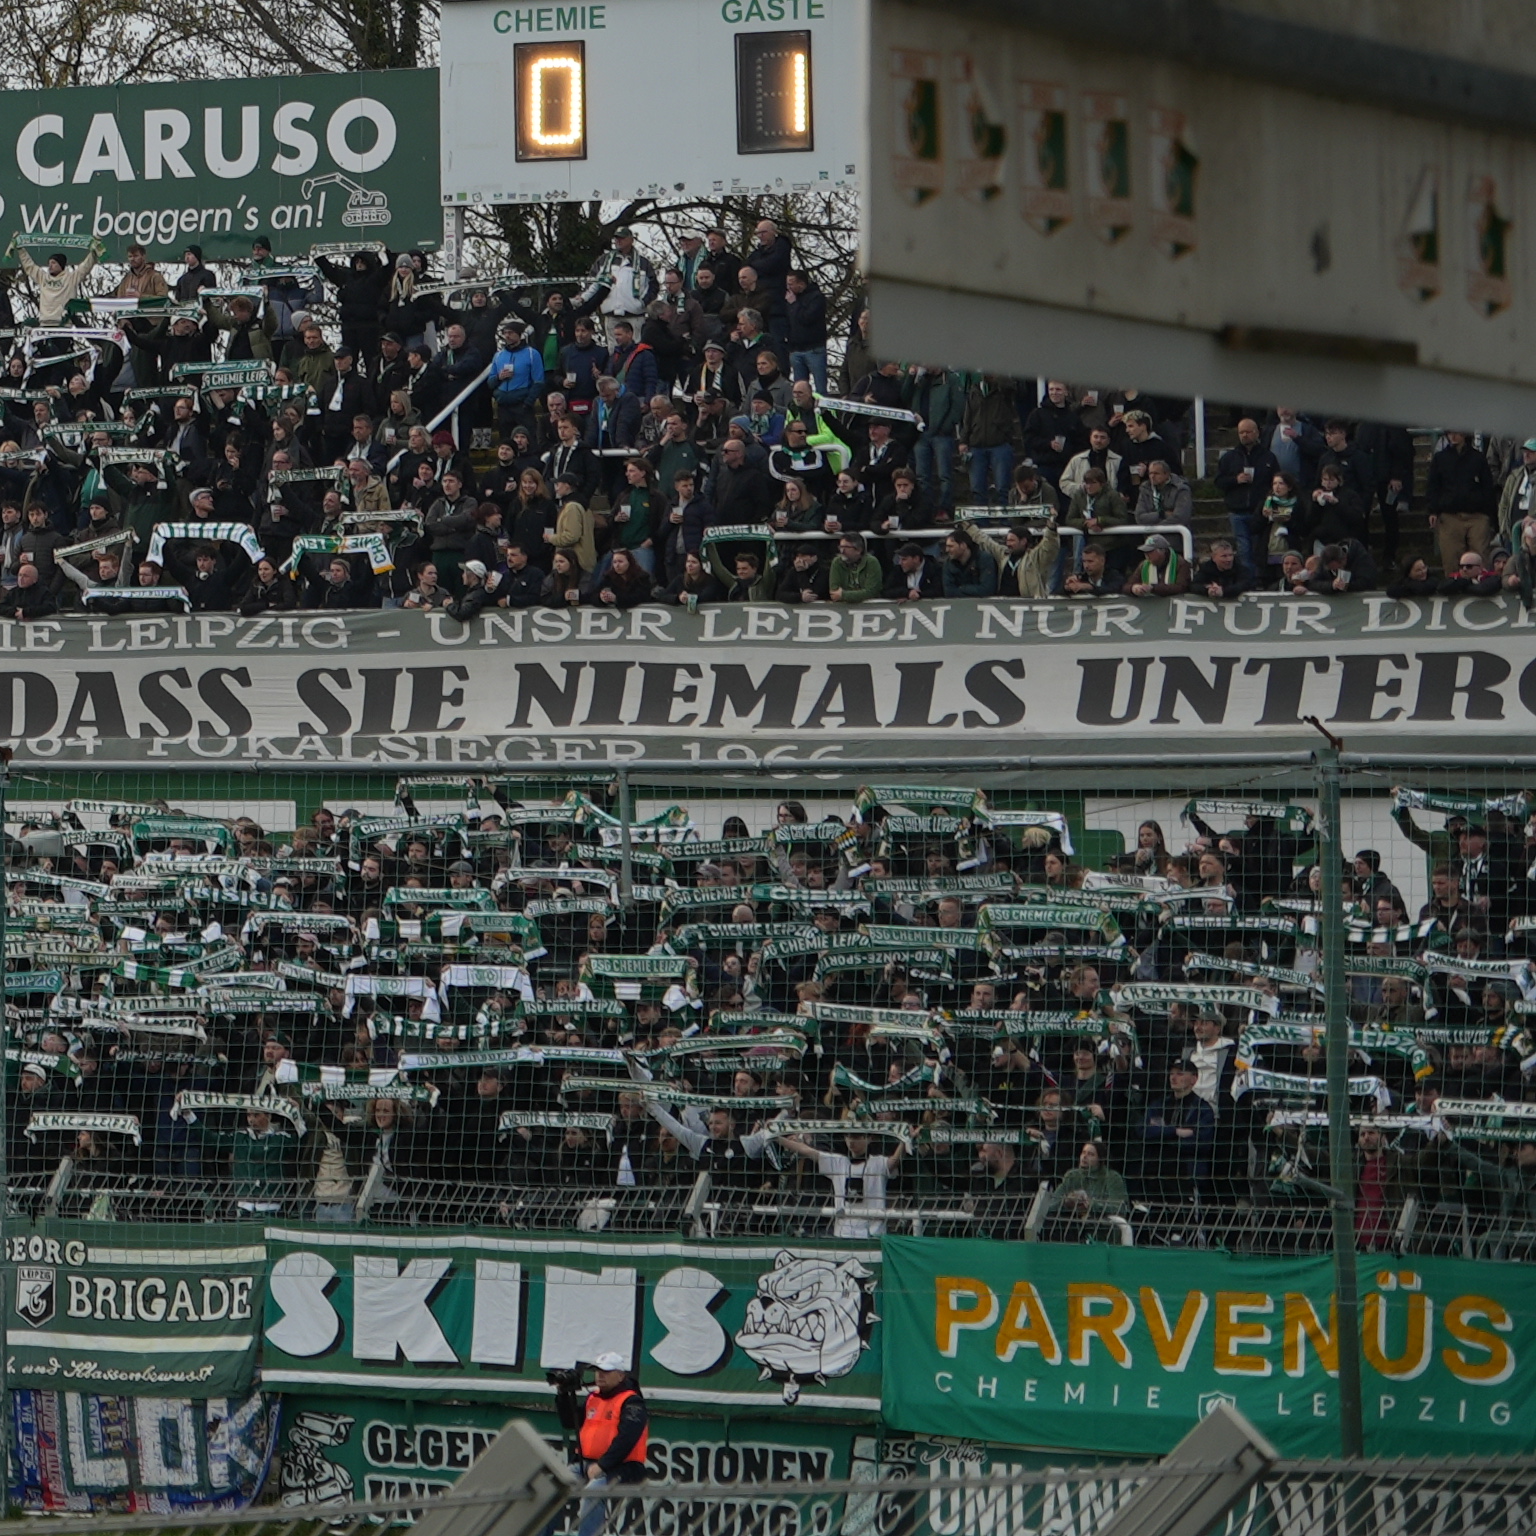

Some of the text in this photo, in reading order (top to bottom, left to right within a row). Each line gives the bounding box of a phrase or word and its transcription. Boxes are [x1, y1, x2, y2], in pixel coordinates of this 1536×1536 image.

[493, 5, 607, 34] CHEMIE
[530, 56, 582, 146] 0
[793, 52, 807, 133] 1
[16, 97, 398, 187] CARUSO
[21, 191, 326, 245] Wir baggern's an!
[88, 614, 348, 652] LEIPZIG
[425, 605, 676, 647] UNSER
[698, 606, 952, 644] LEBEN
[975, 602, 1144, 640] NUR
[1168, 598, 1338, 637] FÜR
[292, 664, 471, 737] SIE
[513, 659, 1028, 730] NIEMALS
[1073, 650, 1536, 728] UNTER
[895, 791, 934, 804] CHEMIE
[936, 792, 975, 806] LEIPZIG
[890, 931, 930, 945] CHEMIE
[933, 932, 977, 947] LEIPZIG
[990, 906, 1098, 924] BSG CHEMIE LEIPZIG
[66, 1276, 254, 1324] BRIGADE
[263, 1250, 728, 1376] SKINS
[933, 1269, 1516, 1386] PARVENÜS
[934, 1370, 1512, 1426] CHEMIE LEPZIG
[928, 1458, 1143, 1536] UMLAN
